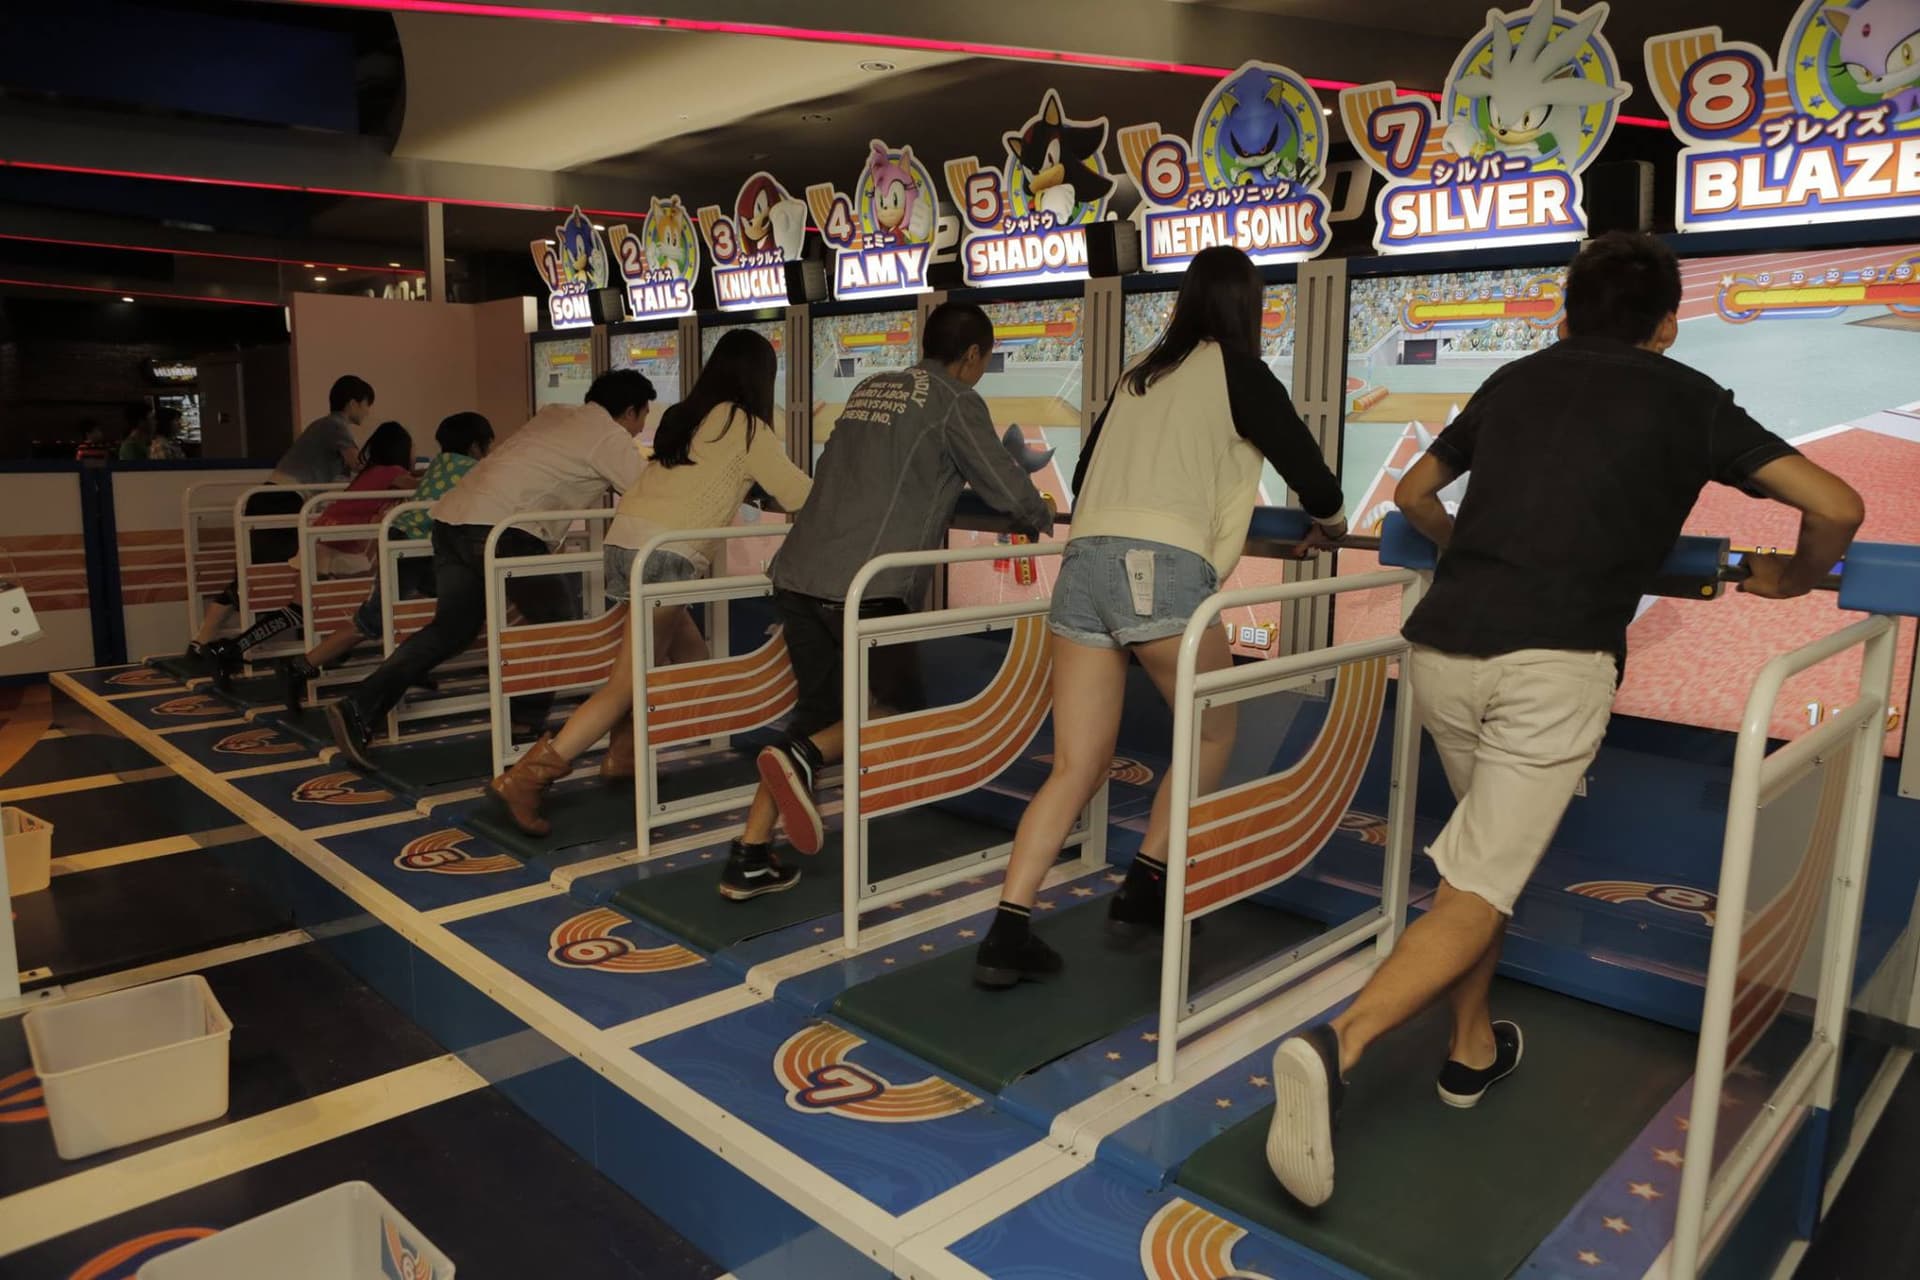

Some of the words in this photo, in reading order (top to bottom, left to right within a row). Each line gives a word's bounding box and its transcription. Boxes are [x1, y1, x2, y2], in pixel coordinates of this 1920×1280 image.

[1688, 58, 1750, 125] 8
[1375, 110, 1420, 165] 7
[1764, 105, 1891, 147] ブレイズ
[1147, 147, 1182, 196] 6
[1433, 155, 1526, 186] シルバー
[968, 177, 998, 221] 5
[1188, 181, 1291, 211] メタルソニック
[1389, 178, 1574, 239] SILVER
[827, 201, 852, 240] 4
[1004, 213, 1055, 235] シャドウ
[1153, 211, 1234, 254] METAL
[1235, 201, 1317, 249] SONIC
[622, 239, 641, 275] 2
[713, 222, 735, 260] 3
[737, 249, 785, 268] ナックルズ
[863, 234, 896, 250] エミー
[545, 253, 557, 288] 1
[718, 267, 787, 300] KNUCKLE
[841, 250, 924, 290] AMY
[553, 292, 592, 322] SONI
[631, 283, 689, 313] TAILS
[565, 939, 629, 963] 6
[803, 1064, 881, 1104] 7
